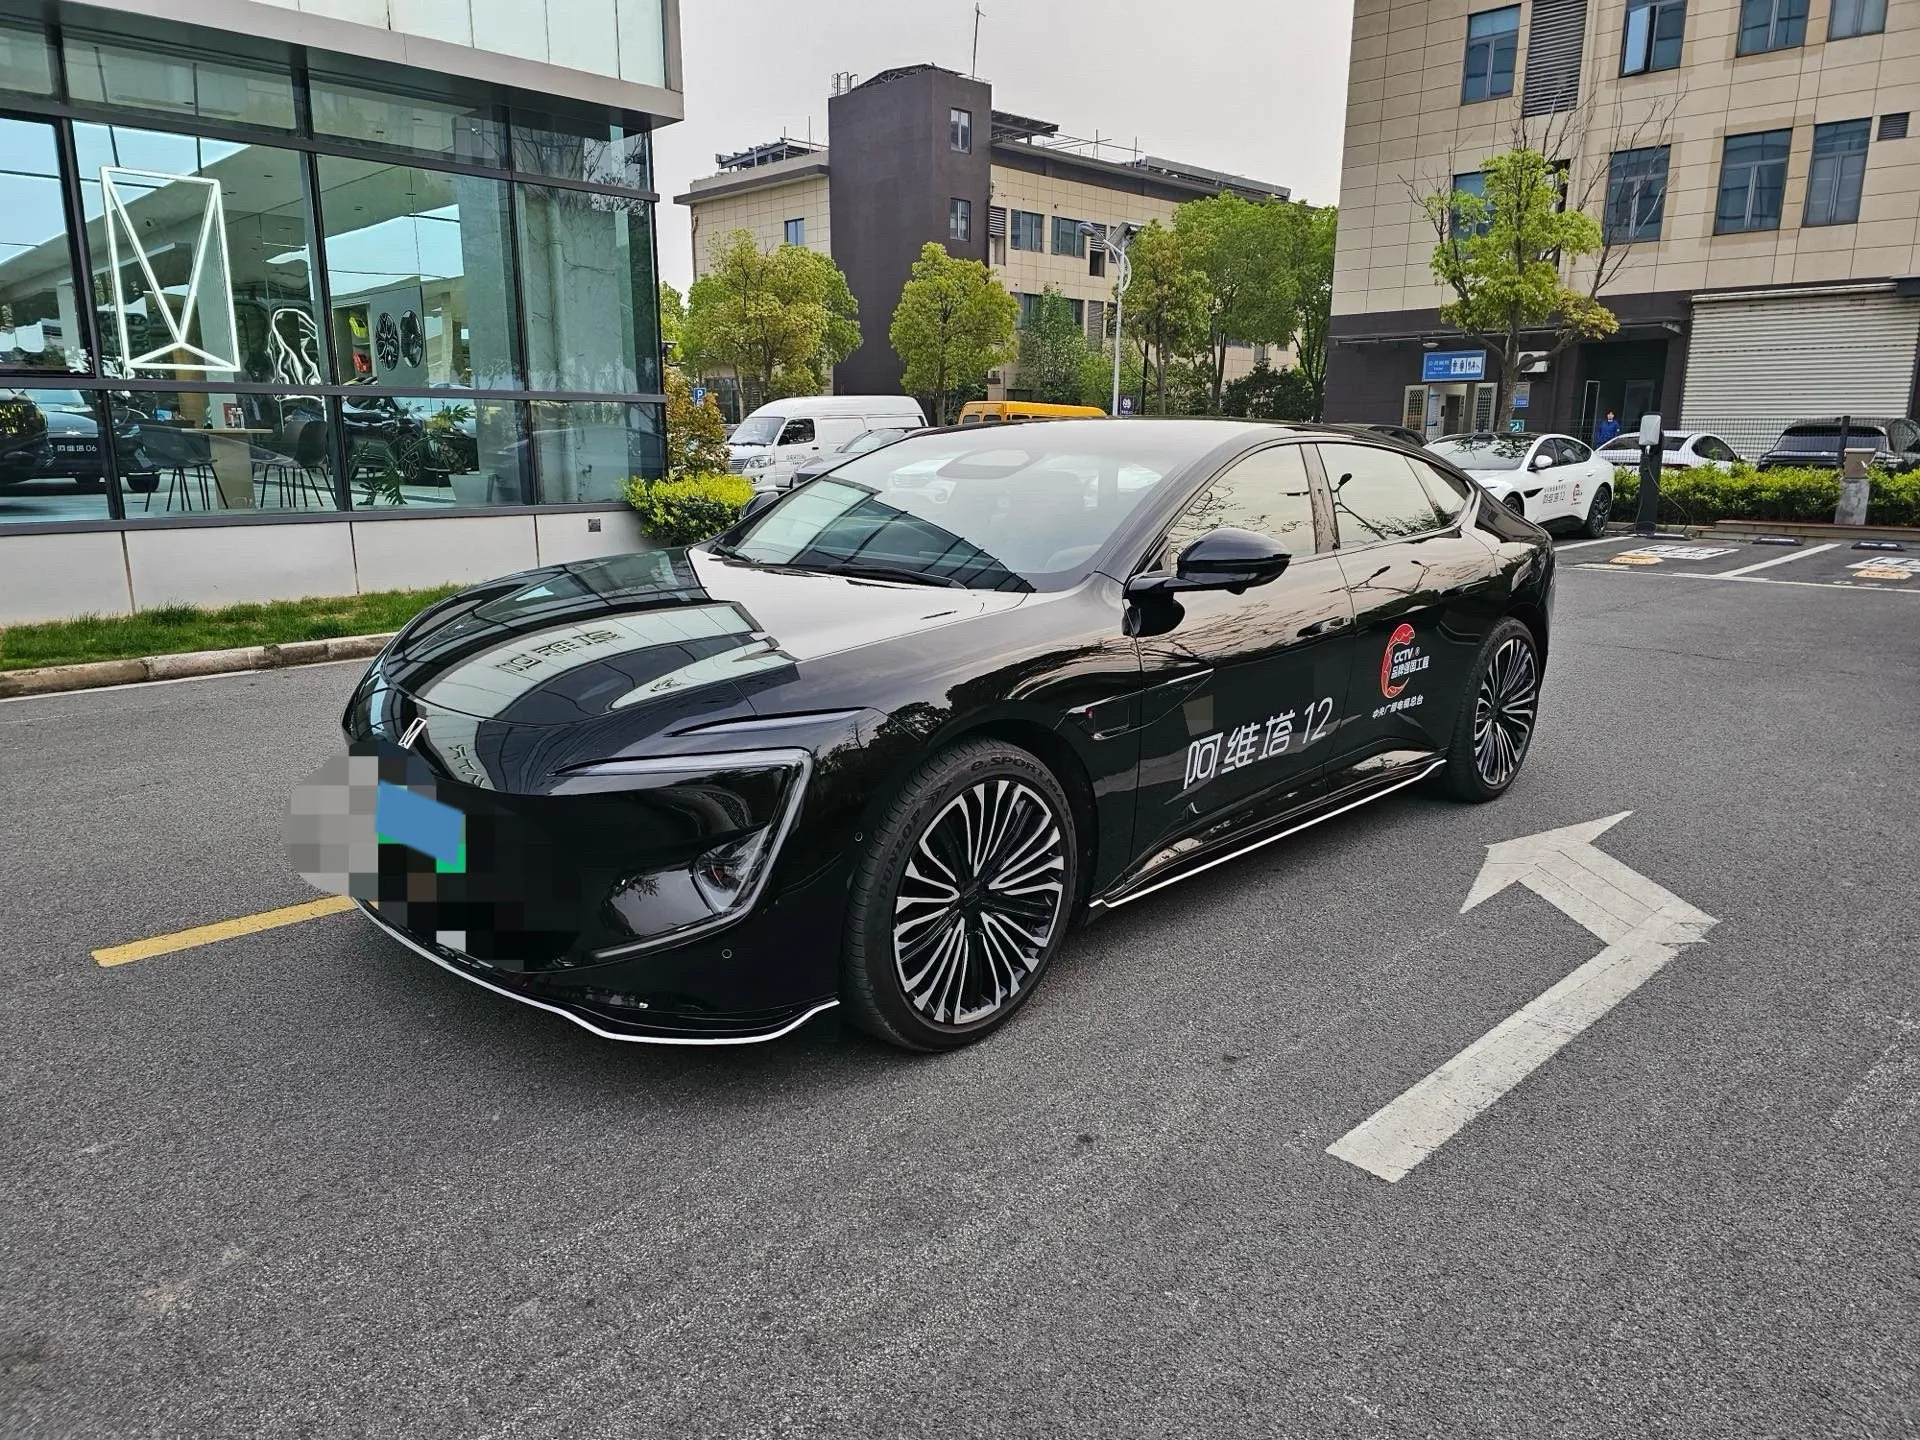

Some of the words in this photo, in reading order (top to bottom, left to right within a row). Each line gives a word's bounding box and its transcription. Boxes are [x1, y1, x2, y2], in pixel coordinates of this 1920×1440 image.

[697, 389, 703, 399] P
[85, 444, 97, 452] 06
[1394, 647, 1414, 663] CCTV
[1183, 709, 1296, 790] 阿维塔
[1302, 697, 1333, 744] 12
